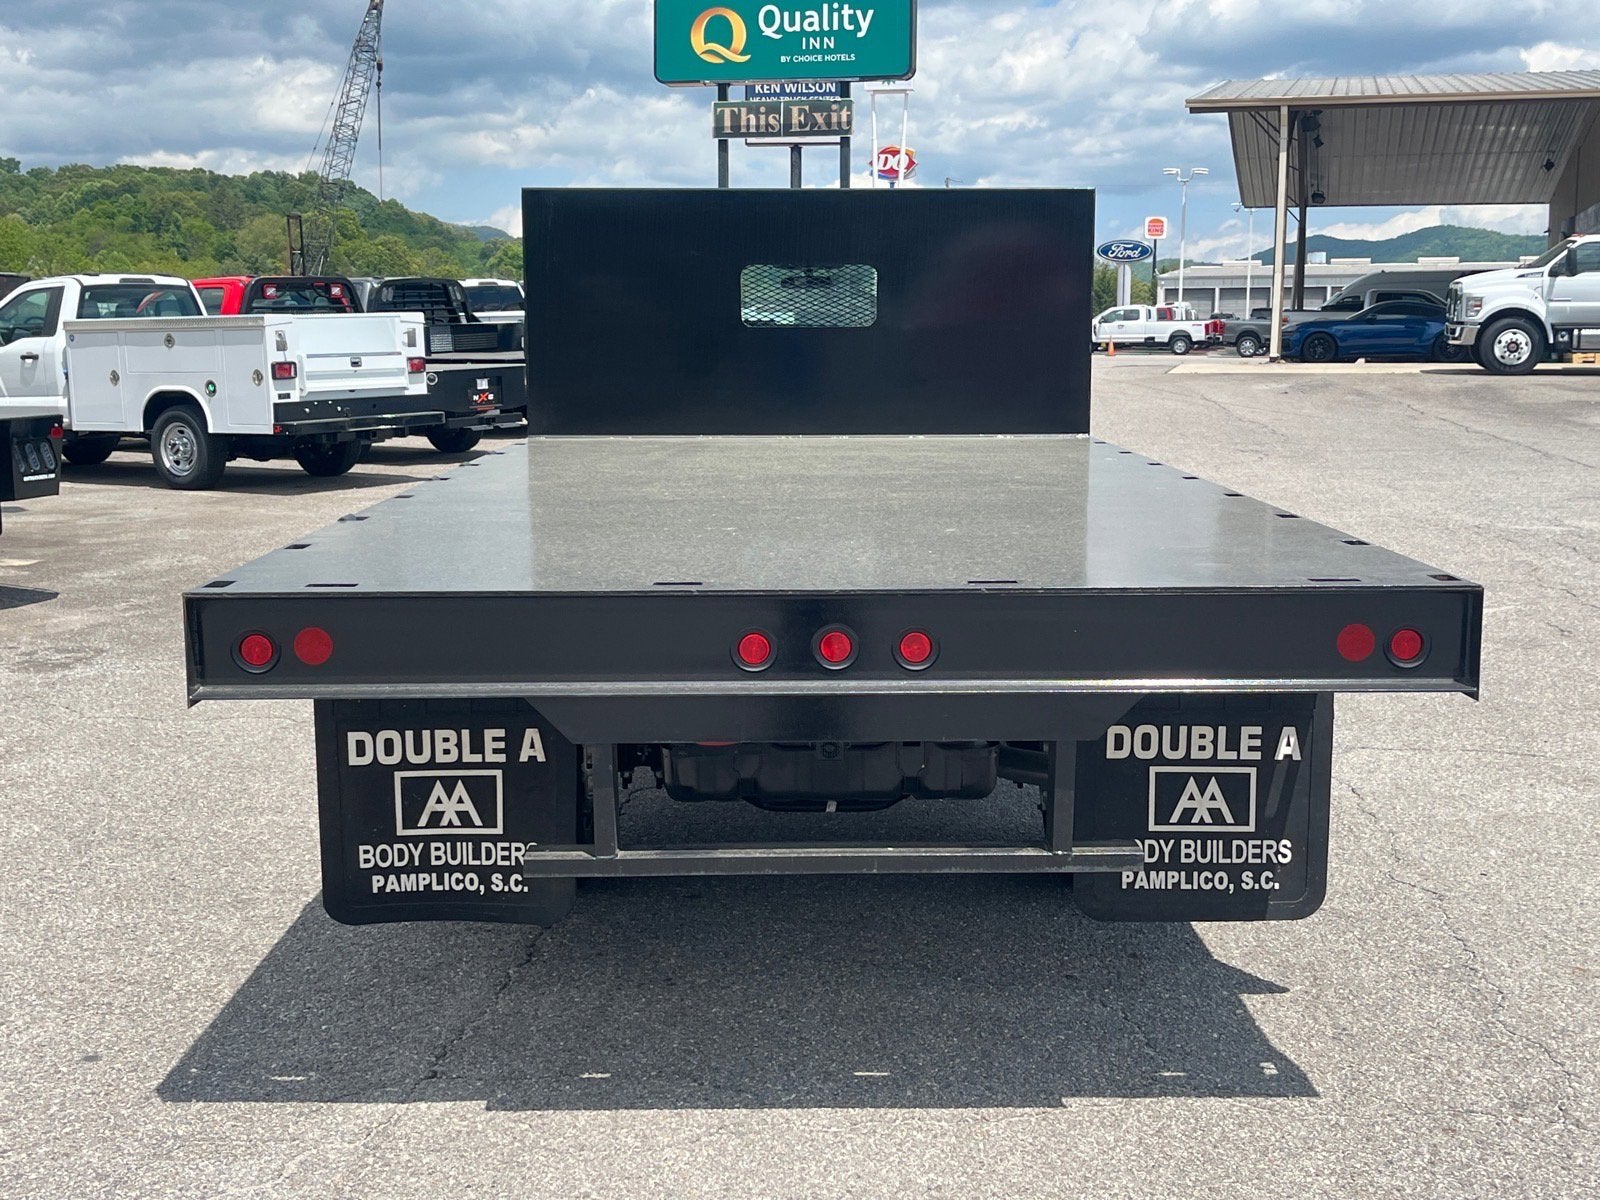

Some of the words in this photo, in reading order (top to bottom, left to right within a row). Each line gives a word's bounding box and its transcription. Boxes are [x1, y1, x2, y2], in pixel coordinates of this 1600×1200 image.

[758, 3, 874, 39] Quality
[802, 36, 835, 50] INN
[780, 55, 791, 63] BY
[793, 54, 823, 62] CHOICE
[824, 53, 856, 62] HOTELS
[755, 83, 780, 94] KEN
[784, 82, 836, 93] WILSON
[716, 105, 780, 134] This
[789, 104, 851, 132] Exit
[878, 153, 910, 172] DQ
[1107, 243, 1142, 258] Ford
[347, 729, 507, 766] DOUBLE
[519, 728, 546, 762] A
[1106, 725, 1263, 760] DOUBLE
[1274, 726, 1302, 761] A
[358, 843, 424, 869] BODY
[430, 842, 538, 866] BUILDER
[1134, 839, 1175, 864] DY
[1180, 839, 1293, 864] BUILDERS
[372, 873, 485, 895] PAMPLICO,
[490, 873, 529, 892] S.C.
[1121, 871, 1234, 894] PAMPLICO,
[1241, 871, 1280, 890] S.C.
